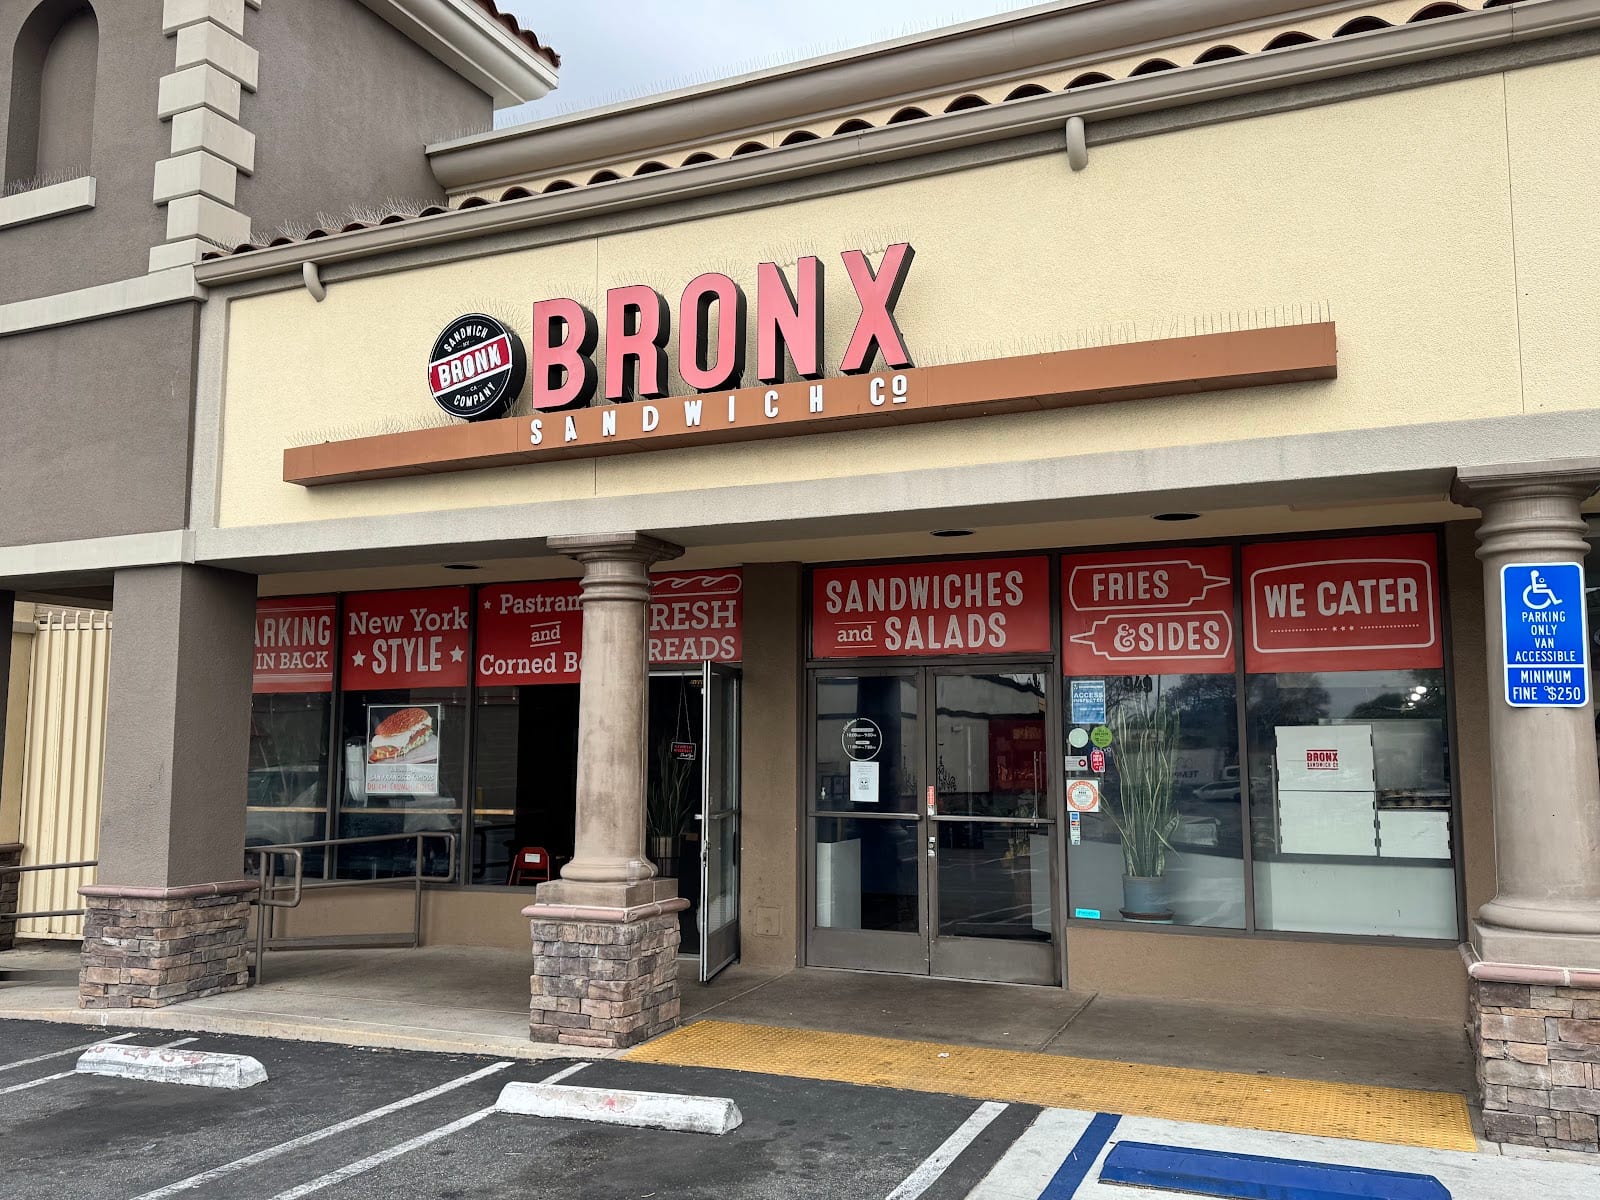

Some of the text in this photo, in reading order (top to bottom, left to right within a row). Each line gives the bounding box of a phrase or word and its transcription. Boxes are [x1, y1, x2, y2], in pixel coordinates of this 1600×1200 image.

[443, 325, 488, 352] SANDWICH
[533, 242, 914, 412] BRONX
[453, 382, 496, 407] COMPANY
[530, 384, 824, 445] SANDWICH
[826, 570, 1024, 614] SANDWICHES
[1093, 569, 1169, 601] FRIES
[1264, 577, 1418, 618] WE CATER
[500, 594, 583, 615] Pastram
[650, 600, 737, 631] RESH
[1522, 611, 1566, 622] PARKING
[255, 615, 331, 648] ARKING
[349, 606, 468, 635] New York
[531, 625, 560, 642] and
[837, 612, 1006, 650] and SALADS
[1531, 624, 1557, 636] ONLY
[372, 636, 443, 674] STYLE
[649, 635, 735, 662] READS
[1534, 637, 1554, 649] VAN
[256, 651, 328, 669] IN BACK
[480, 652, 556, 675] Corned
[1515, 651, 1576, 662] ACCESSIBLE
[1520, 670, 1572, 684] MINIMUM
[1513, 686, 1581, 701] FINE $250
[1306, 752, 1338, 761] BRONX
